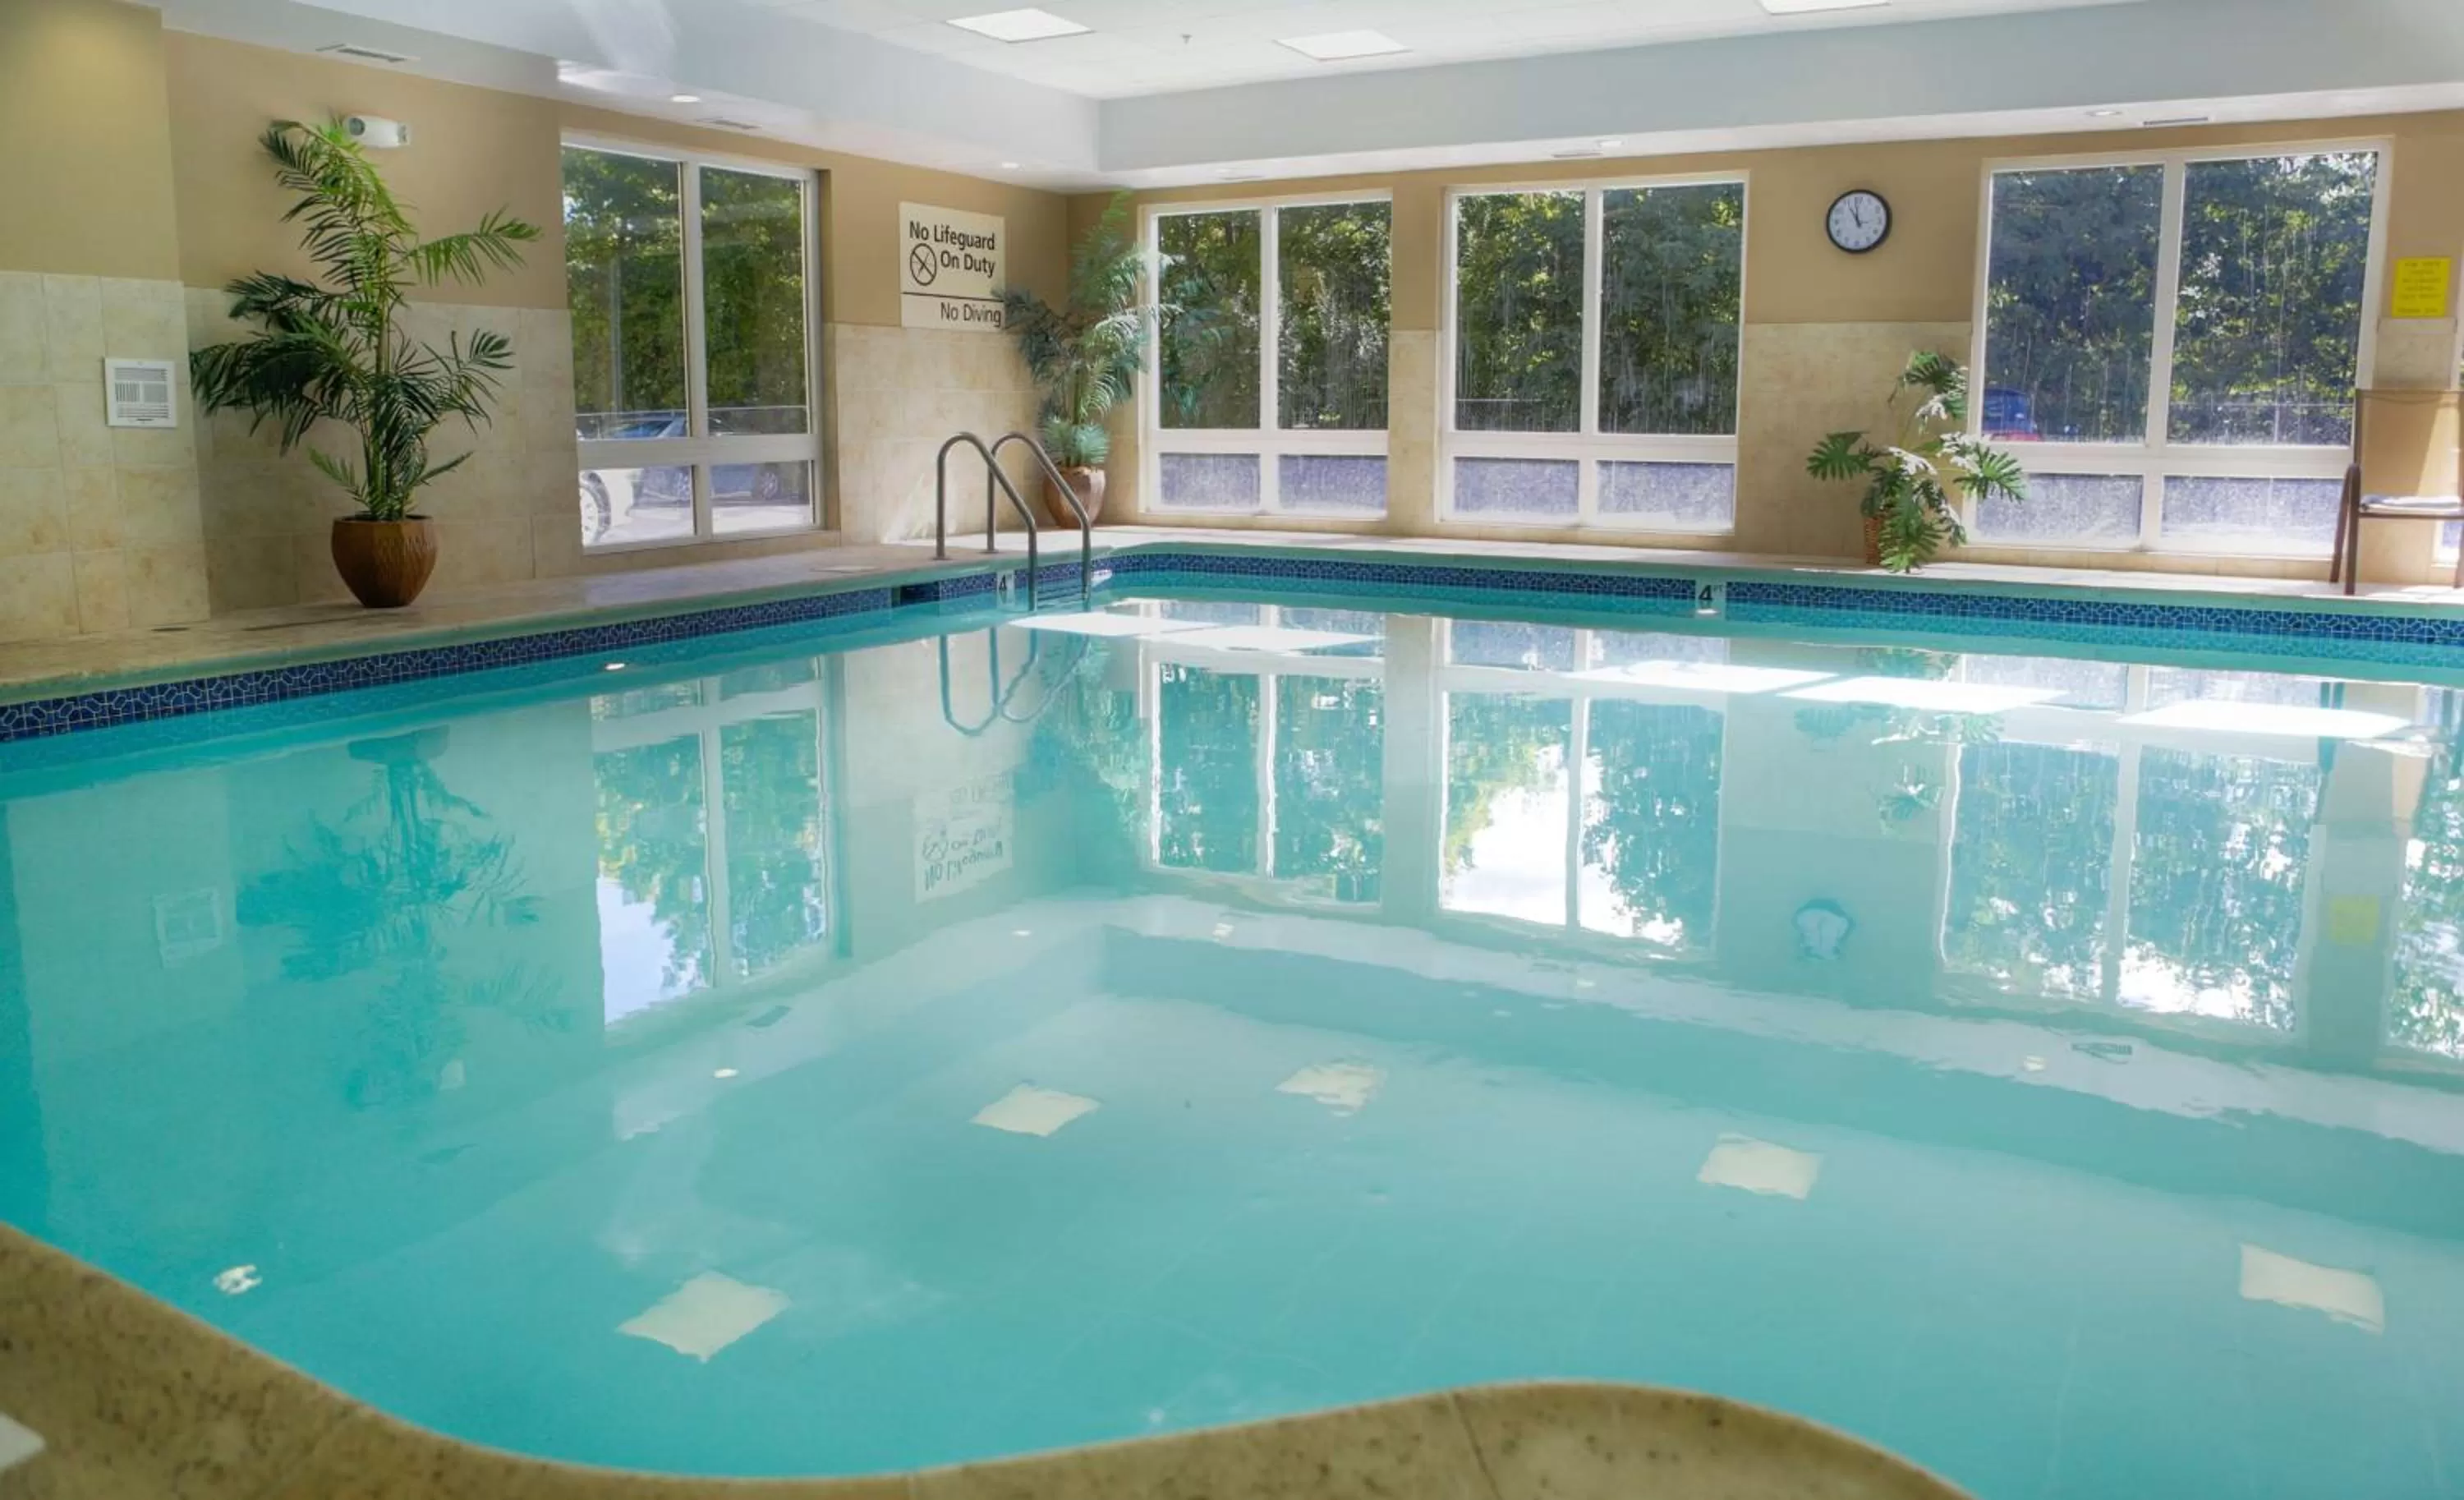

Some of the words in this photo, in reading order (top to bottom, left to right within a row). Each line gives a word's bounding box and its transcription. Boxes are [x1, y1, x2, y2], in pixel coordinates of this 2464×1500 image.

[909, 220, 929, 241] No
[934, 223, 995, 251] Lifeguard
[940, 251, 959, 269] On
[963, 254, 996, 278] Duty
[940, 302, 958, 321] No
[963, 304, 1001, 327] Diving
[1698, 584, 1713, 601] 4
